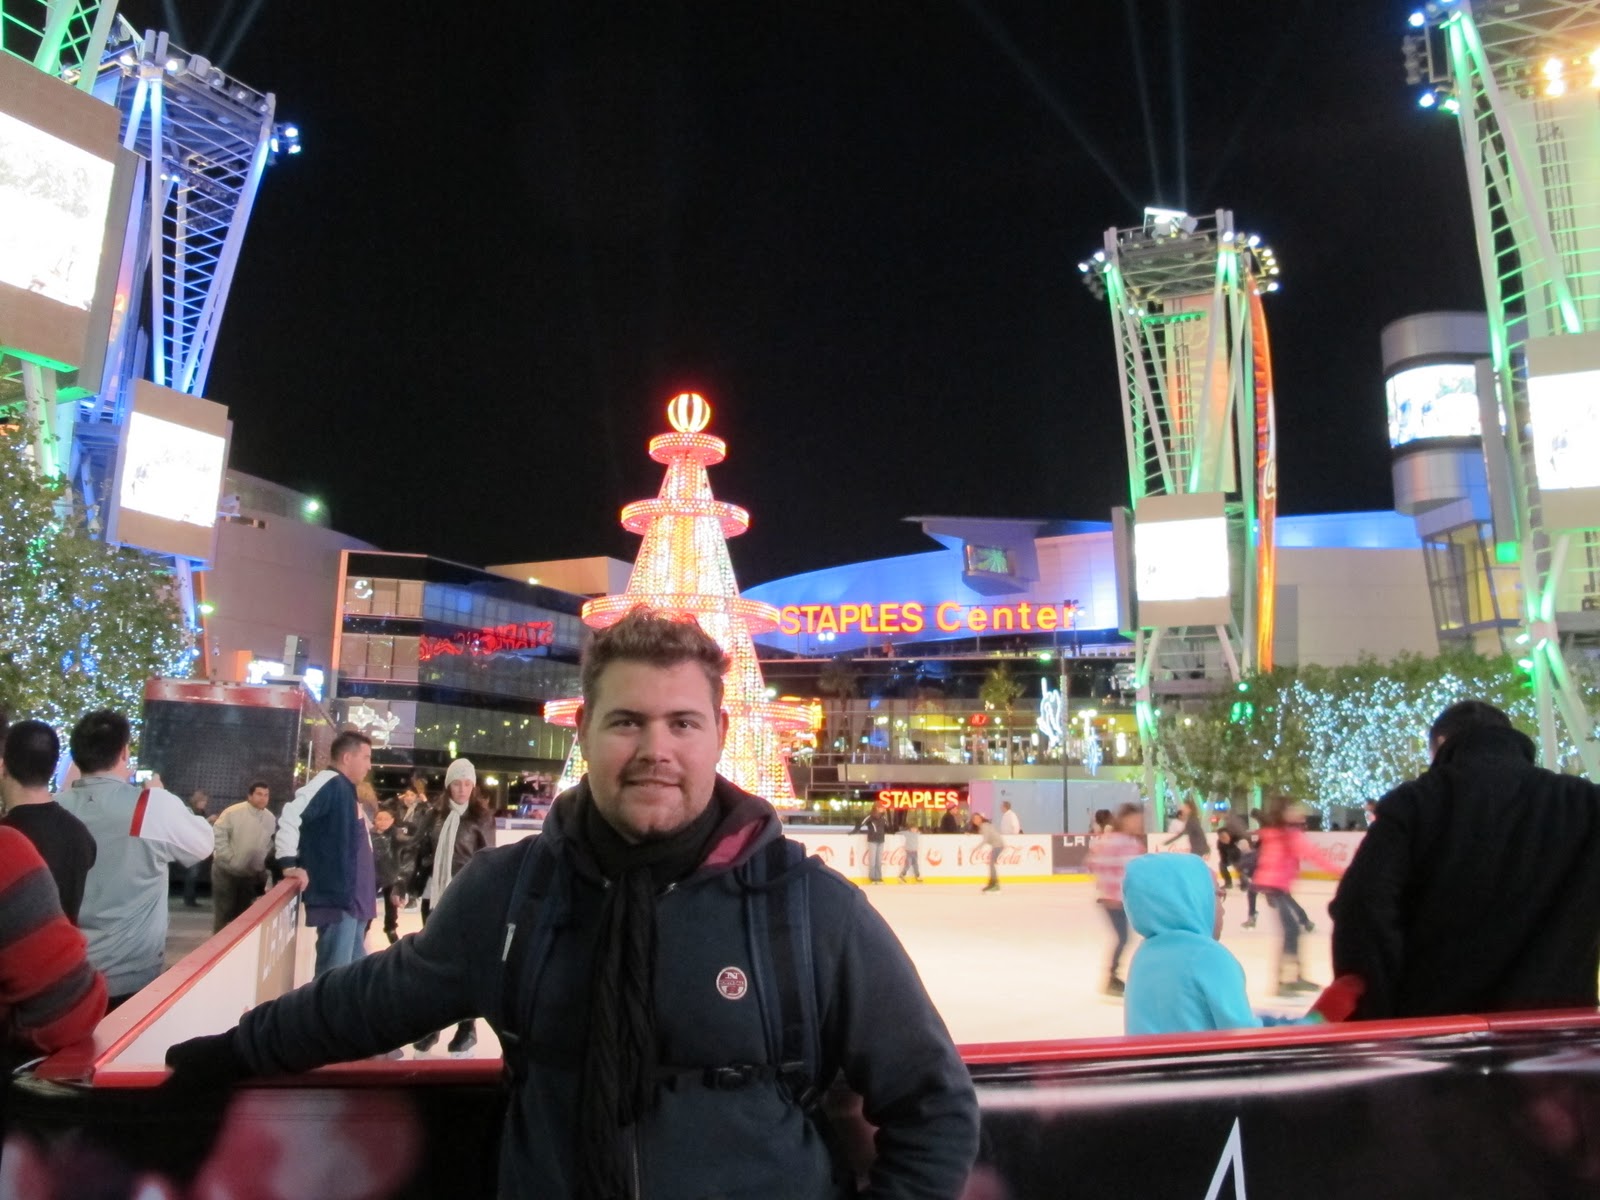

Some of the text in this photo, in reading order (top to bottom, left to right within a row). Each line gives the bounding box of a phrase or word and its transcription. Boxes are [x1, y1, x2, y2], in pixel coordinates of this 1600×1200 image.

[779, 599, 1076, 636] STAPLES Center
[878, 790, 959, 809] STAPLES
[1063, 836, 1085, 847] LA
